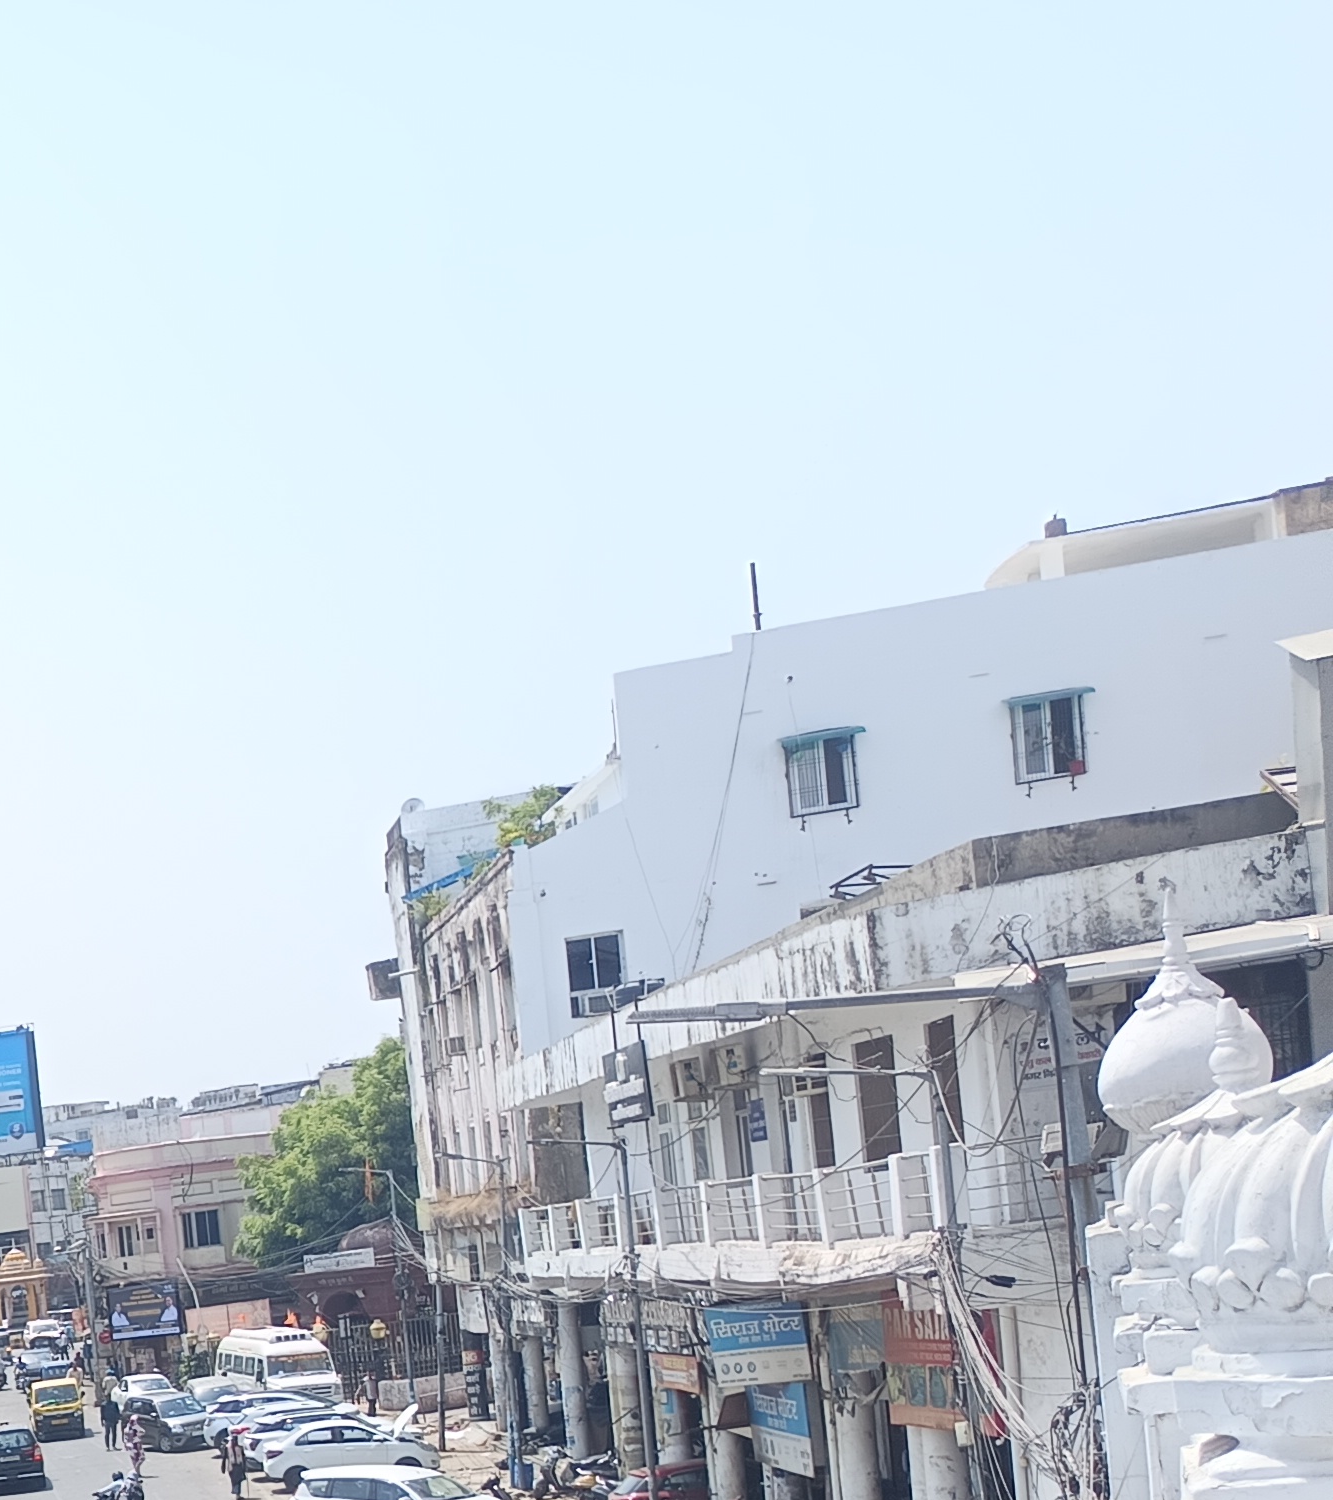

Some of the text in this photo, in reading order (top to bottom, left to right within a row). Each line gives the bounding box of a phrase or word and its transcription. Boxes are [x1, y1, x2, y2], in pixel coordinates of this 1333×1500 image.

[710, 1313, 802, 1339] सिराज मोटर
[884, 1308, 911, 1339] CAR
